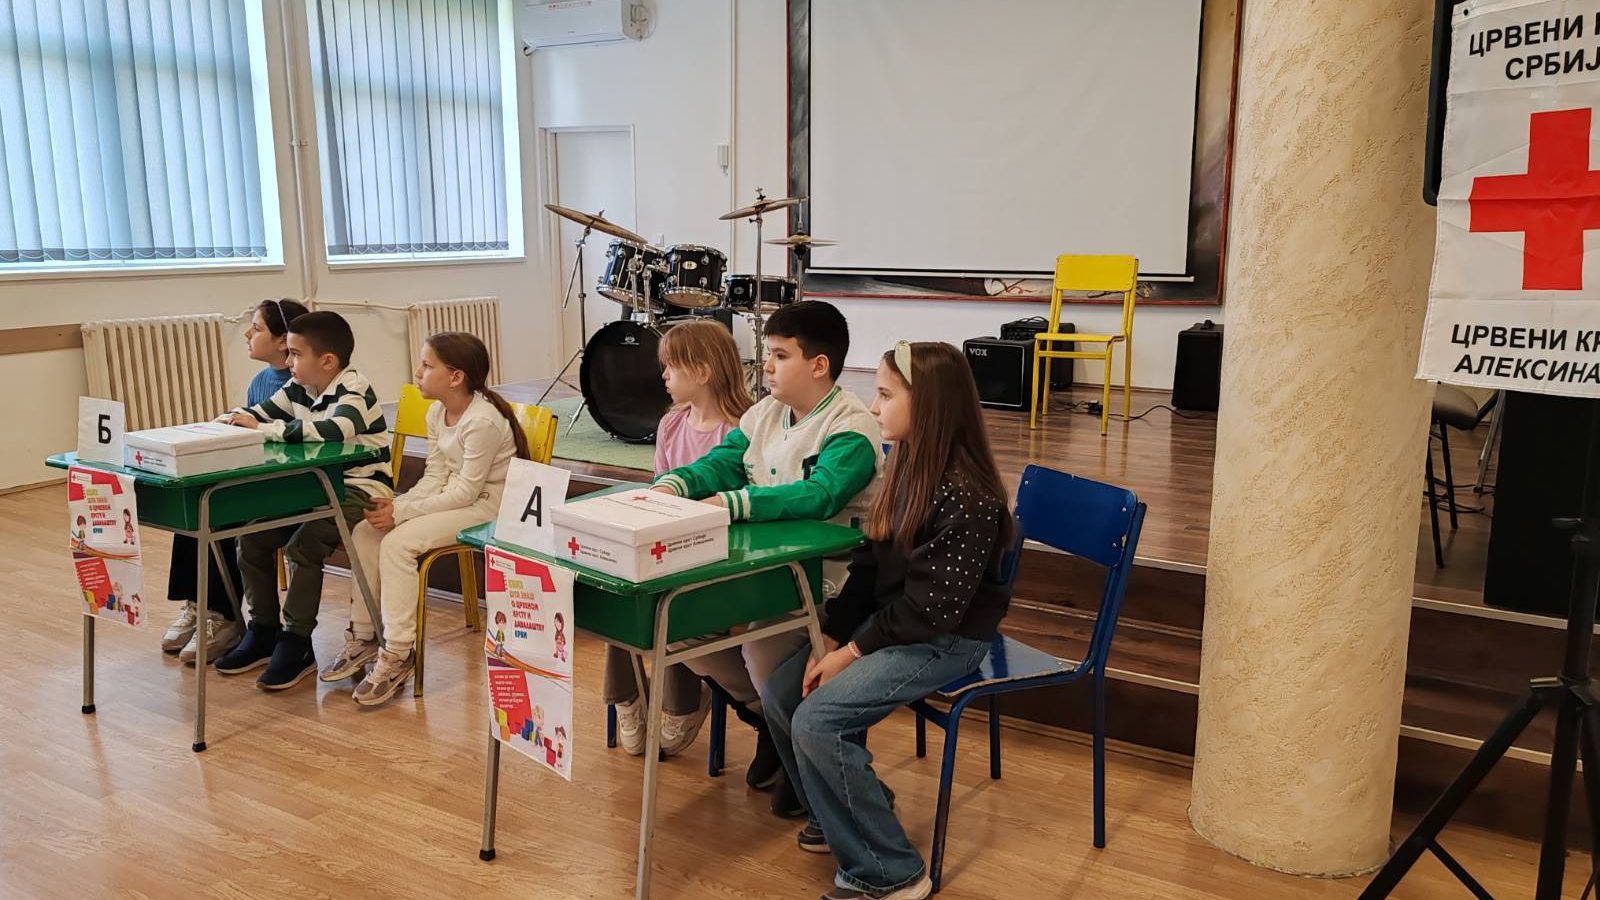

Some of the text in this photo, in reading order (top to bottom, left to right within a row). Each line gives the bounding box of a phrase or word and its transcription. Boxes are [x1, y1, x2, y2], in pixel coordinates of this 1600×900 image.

[1469, 15, 1583, 57] ЦРВЕНИ
[969, 347, 988, 357] VOX
[1451, 324, 1567, 351] ЦРВЕНИ
[1453, 354, 1600, 384] АЛЕКСИНА
[98, 413, 111, 444] Б
[520, 485, 542, 527] А
